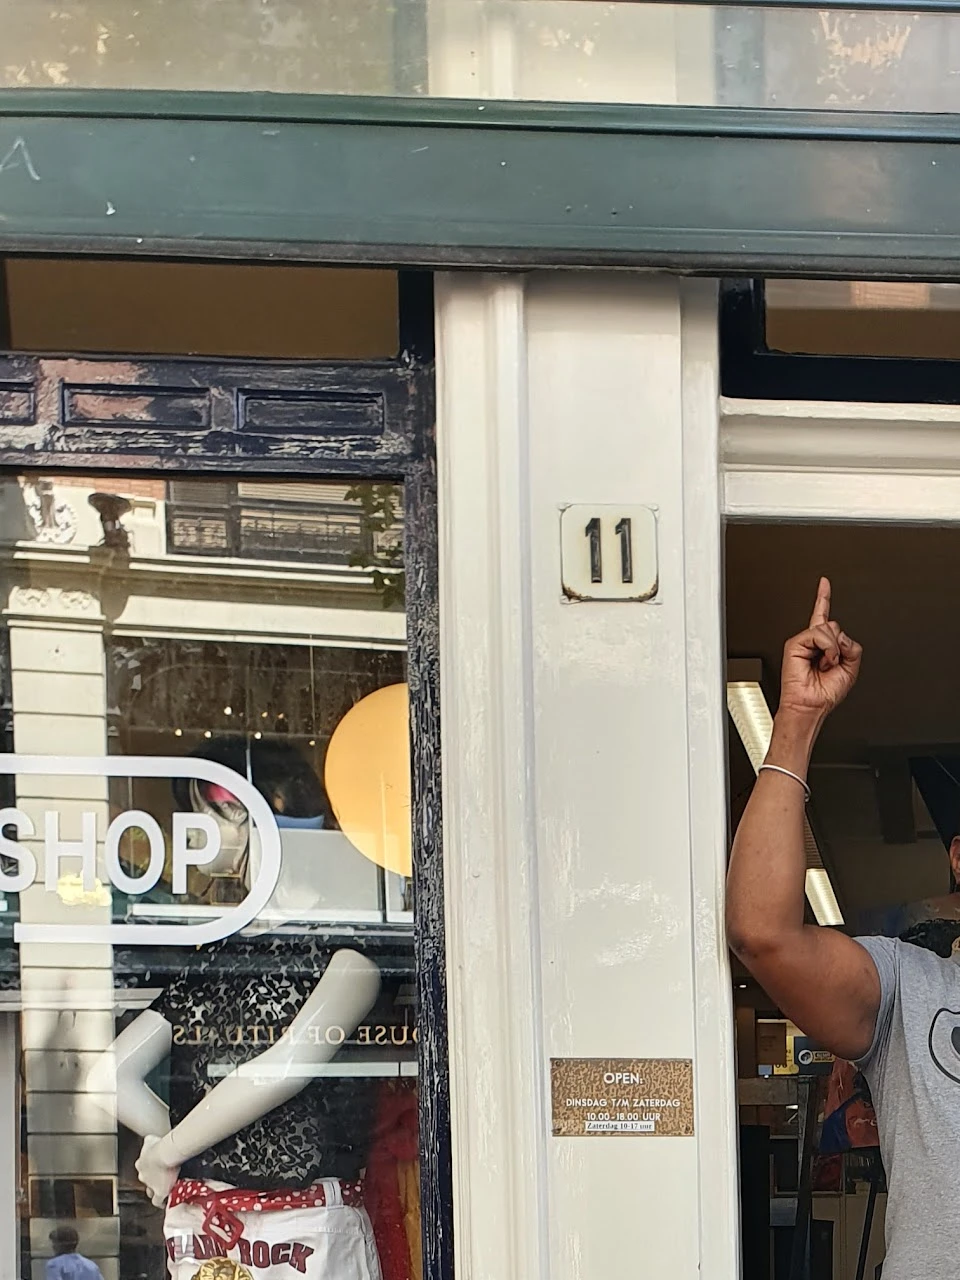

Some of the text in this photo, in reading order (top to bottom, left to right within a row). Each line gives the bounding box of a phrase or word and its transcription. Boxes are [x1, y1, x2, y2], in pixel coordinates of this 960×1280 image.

[584, 517, 633, 584] 11
[0, 806, 222, 895] SHOP
[566, 1098, 681, 1107] DINSDAG T/M ZATERDAG
[587, 1122, 618, 1130] Zaterdag
[642, 1112, 661, 1121] UUR
[238, 1237, 315, 1274] ROCK
